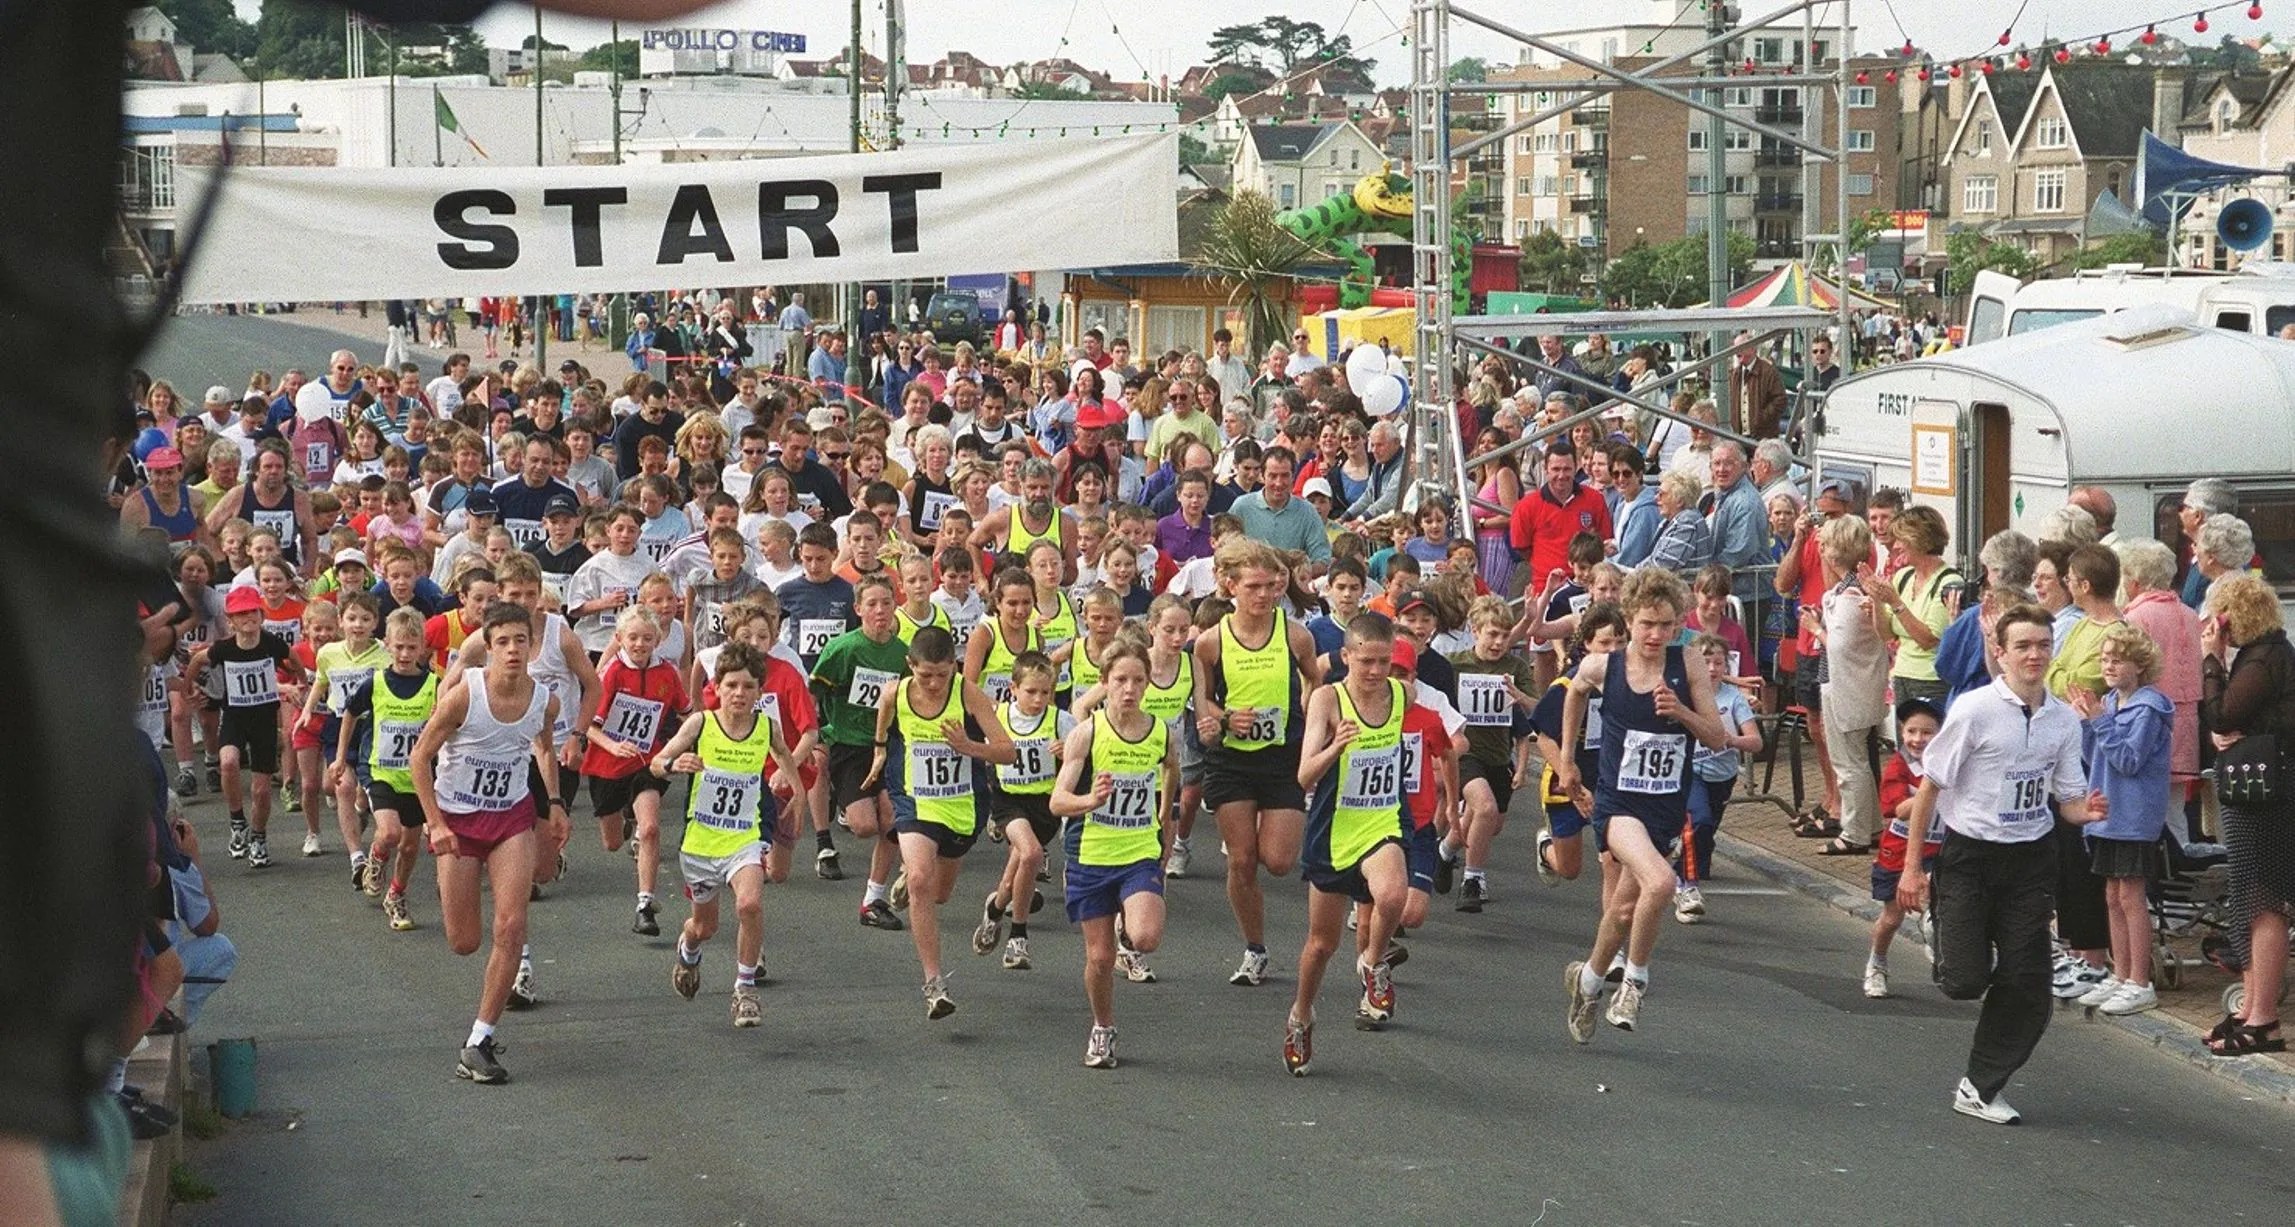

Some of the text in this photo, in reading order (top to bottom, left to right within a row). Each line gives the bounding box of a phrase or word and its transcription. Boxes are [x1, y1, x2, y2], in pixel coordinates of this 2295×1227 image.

[433, 171, 942, 270] START
[1878, 393, 1908, 416] FIRST
[236, 672, 268, 696] 101
[1471, 688, 1506, 713] 110
[617, 710, 652, 739] 143
[925, 756, 963, 786] 157
[1638, 748, 1676, 778] 195
[472, 768, 512, 798] 133
[1360, 764, 1394, 796] 156
[2014, 776, 2045, 810] 196
[712, 786, 744, 817] 33
[1109, 787, 1149, 816] 172
